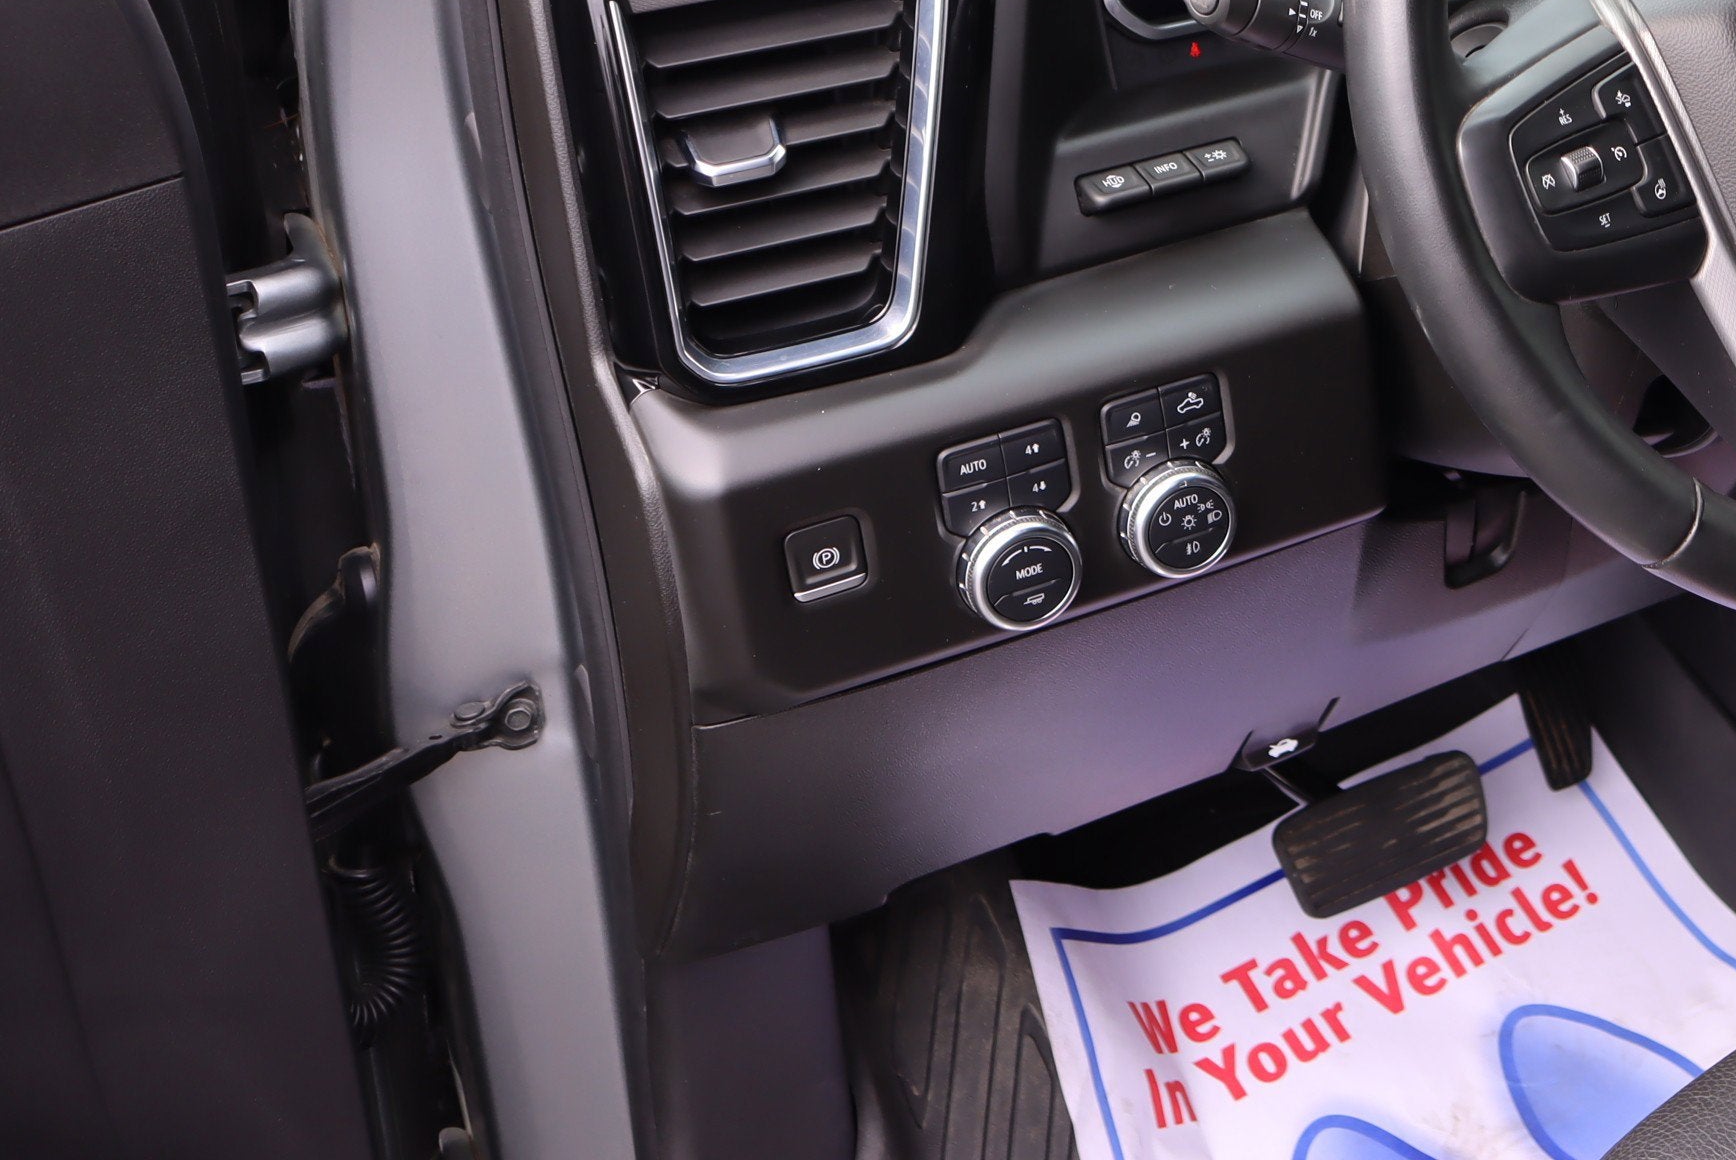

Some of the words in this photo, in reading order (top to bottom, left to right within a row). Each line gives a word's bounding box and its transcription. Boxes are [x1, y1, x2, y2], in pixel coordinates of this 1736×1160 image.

[1309, 10, 1323, 21] OFF
[1558, 113, 1573, 126] RES
[1153, 162, 1178, 174] INFO
[1101, 175, 1125, 188] HUD
[1598, 212, 1611, 226] SET
[959, 458, 987, 476] AUTO
[1173, 494, 1198, 510] AUTO
[1015, 562, 1043, 580] MODE
[1127, 998, 1221, 1055] We
[1220, 919, 1380, 1013] Take
[1383, 831, 1543, 932] Pride
[1144, 1067, 1197, 1129] In
[1193, 1001, 1352, 1102] Your
[1352, 858, 1600, 1015] Vehicle!
